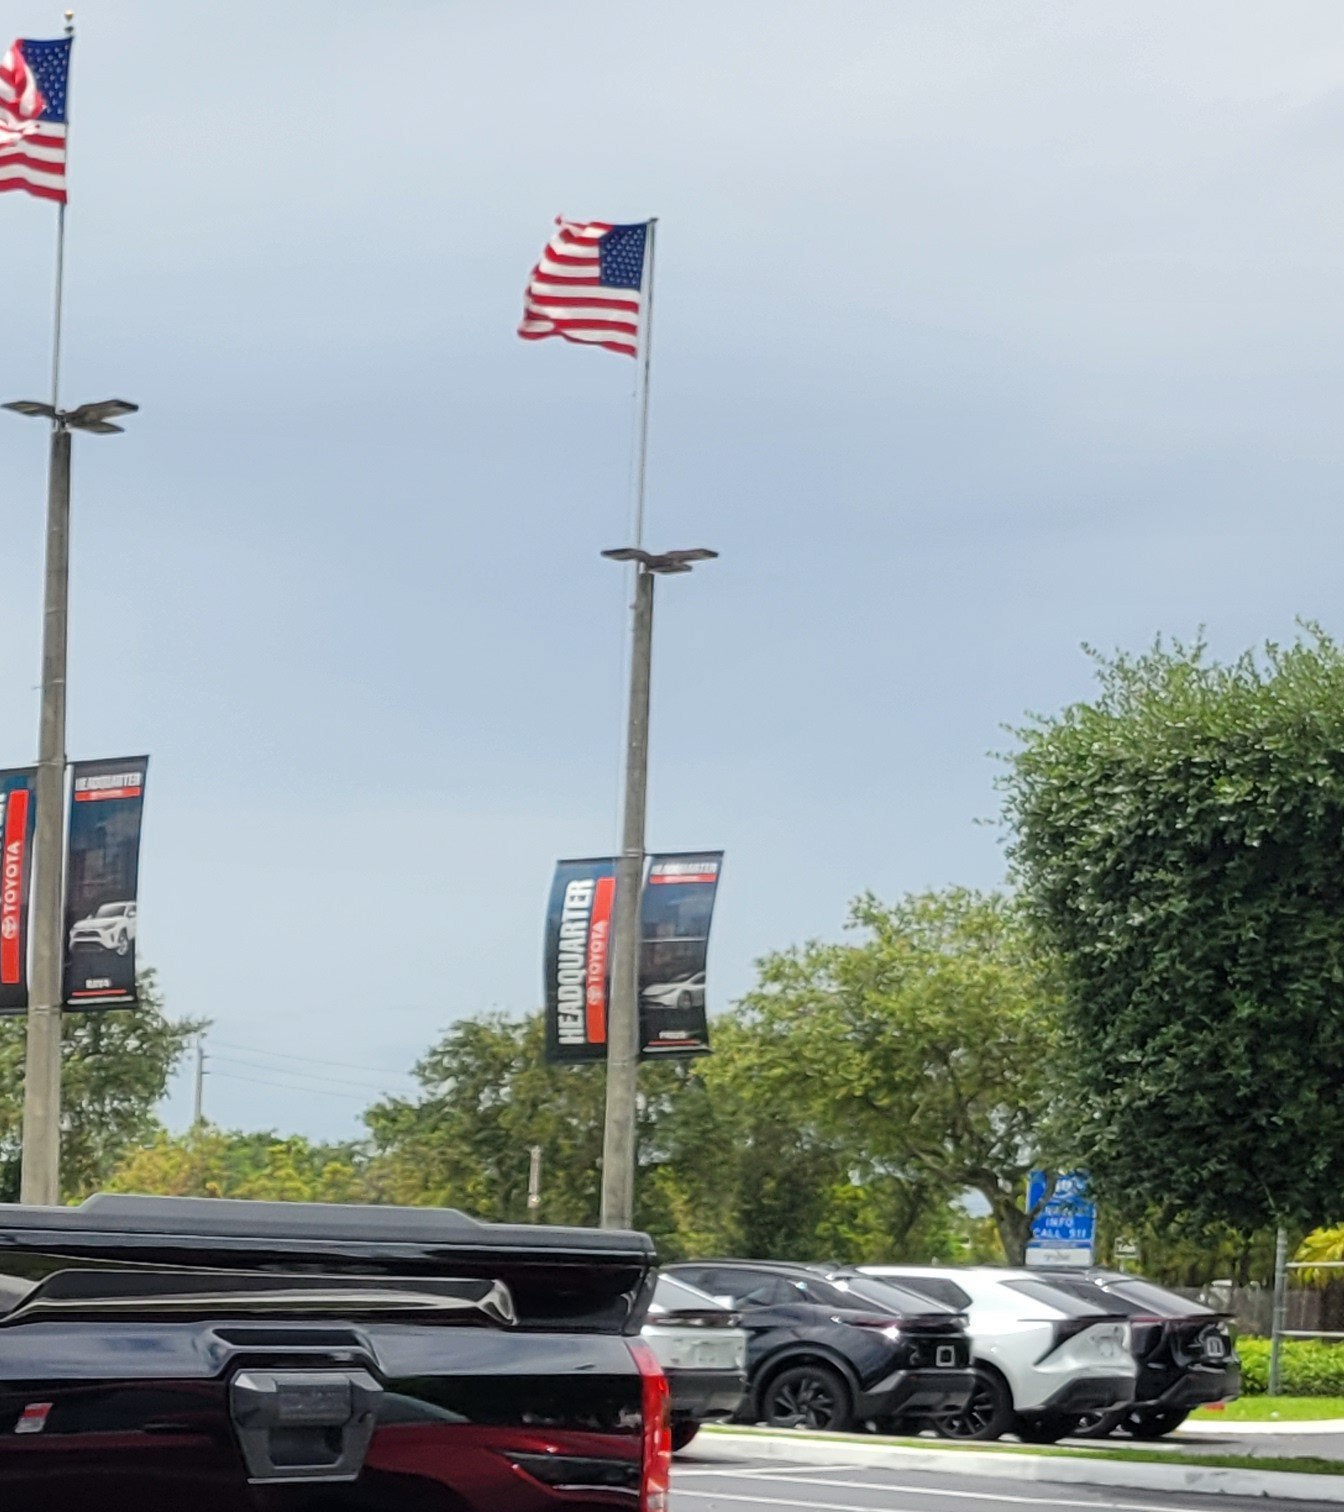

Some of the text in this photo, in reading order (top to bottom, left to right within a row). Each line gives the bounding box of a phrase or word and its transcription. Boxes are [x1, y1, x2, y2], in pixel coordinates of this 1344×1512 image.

[3, 841, 20, 913] TOYOTA
[558, 878, 595, 1045] HEADQUARTER
[588, 921, 608, 983] TOYOTA
[1033, 1229, 1062, 1239] CALL
[1045, 1218, 1074, 1228] INFO
